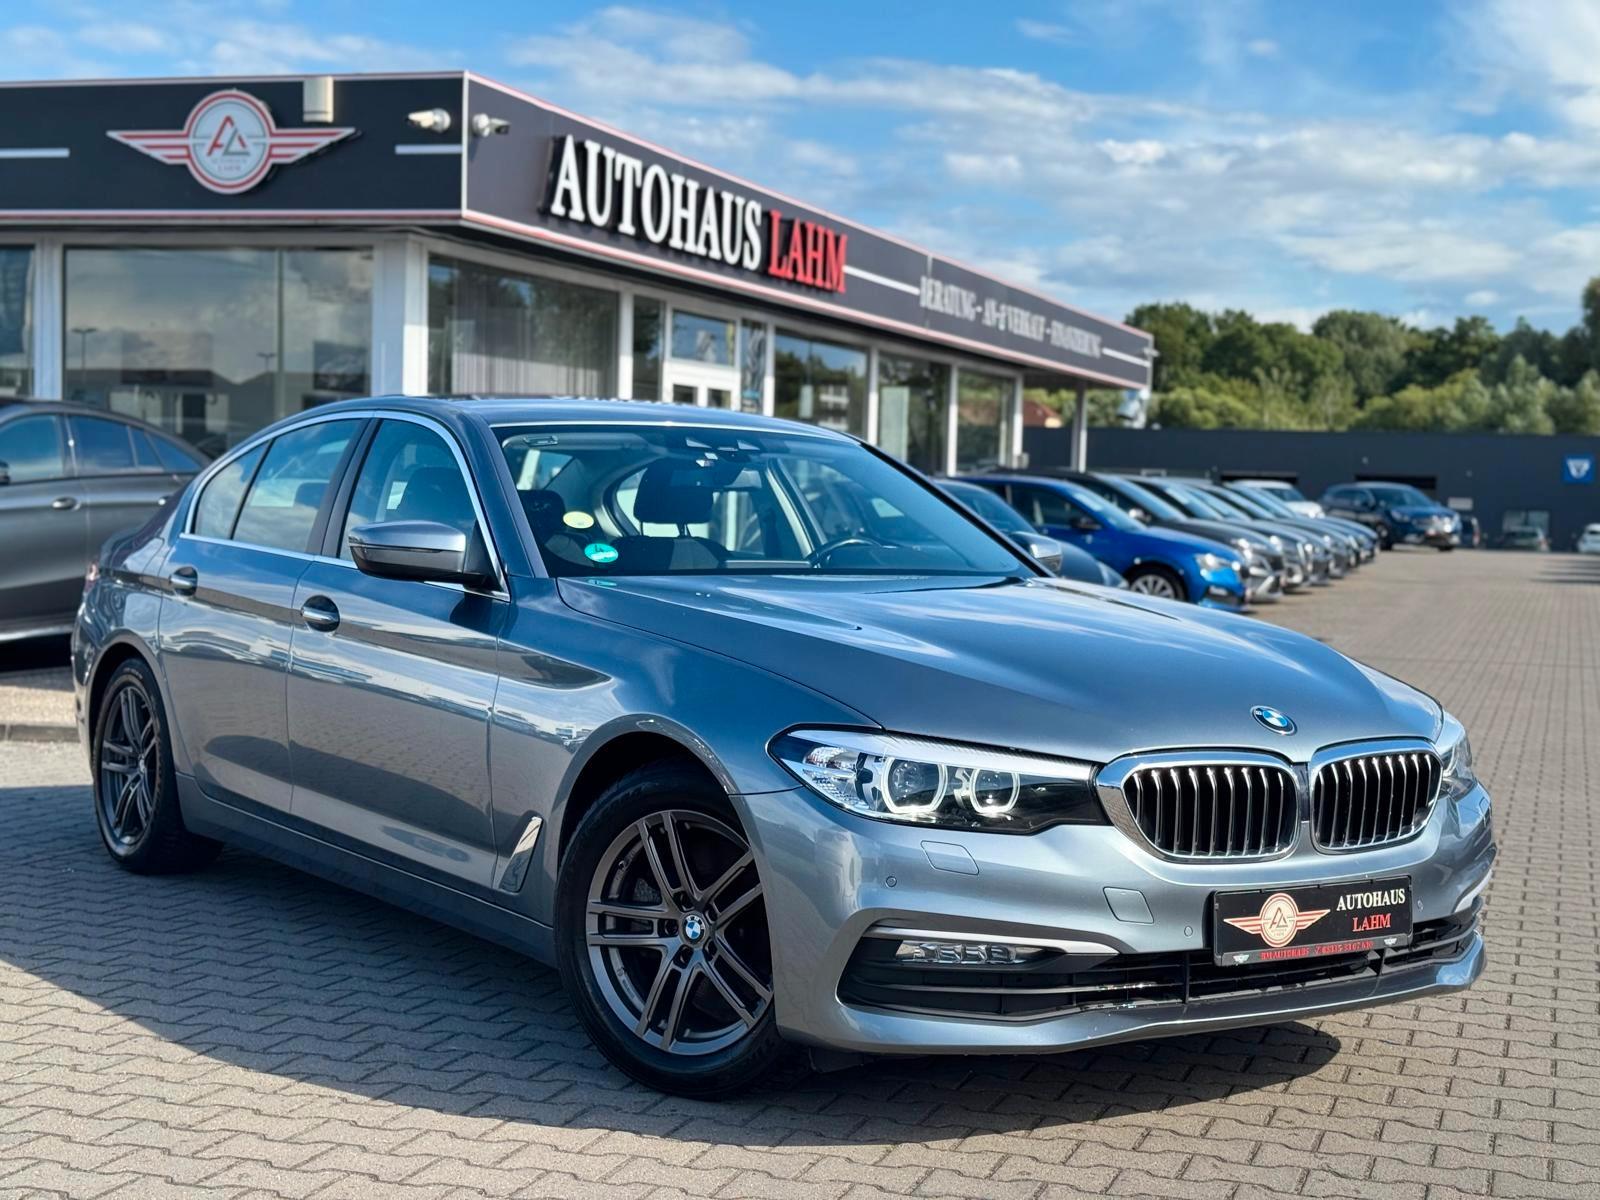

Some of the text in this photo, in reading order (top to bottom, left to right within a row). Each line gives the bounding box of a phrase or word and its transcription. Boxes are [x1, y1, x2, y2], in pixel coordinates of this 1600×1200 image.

[551, 134, 848, 294] AUTOHAUS LAHM
[1336, 888, 1406, 912] AUTOHAUS
[1352, 912, 1392, 932] LAHM
